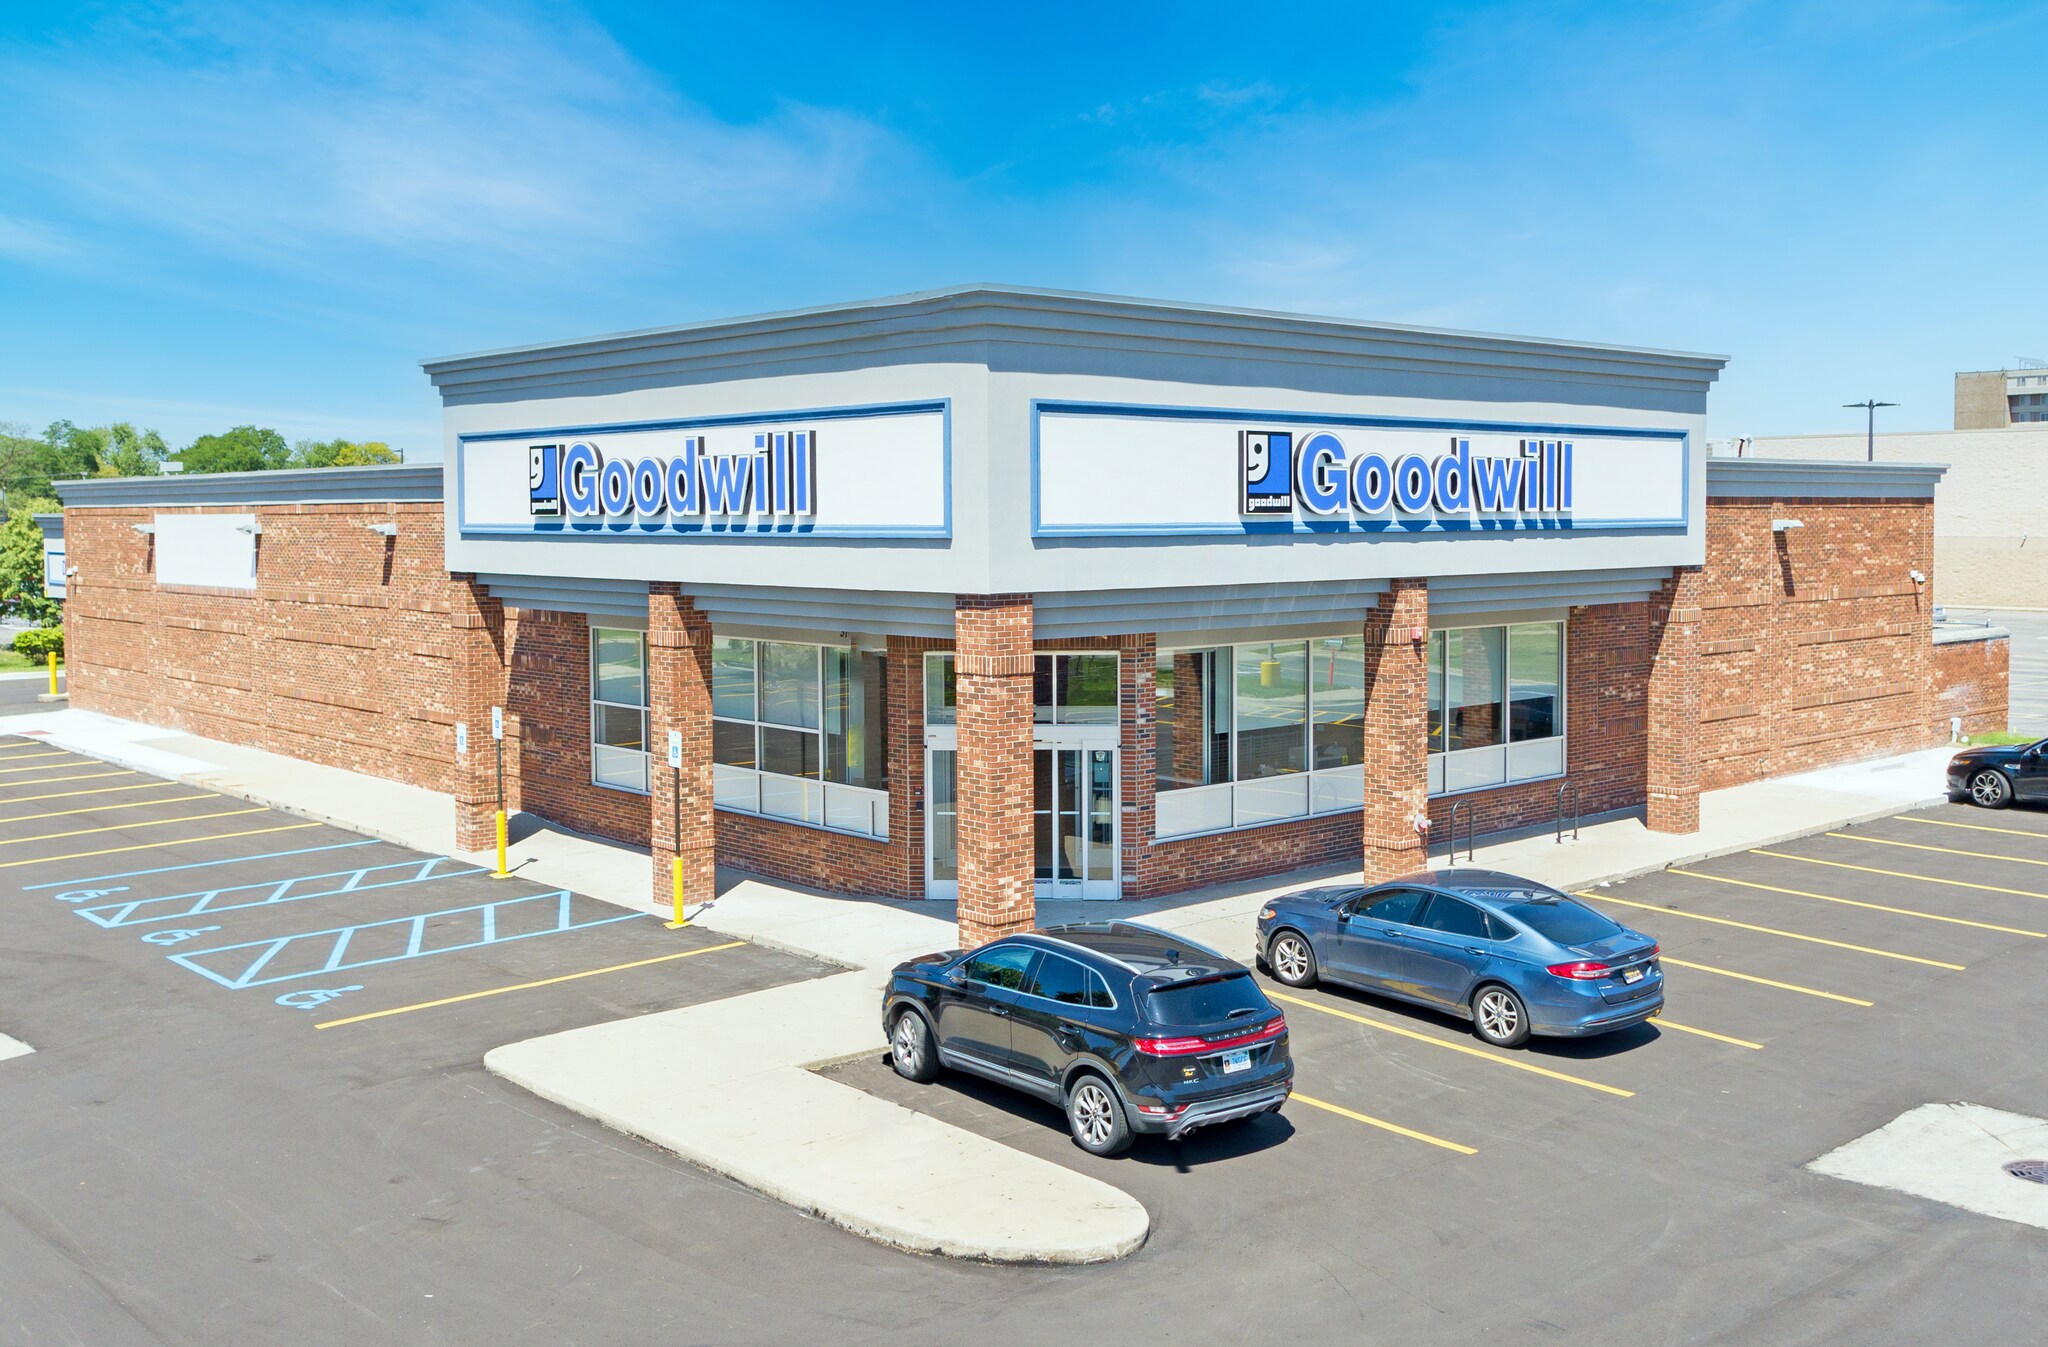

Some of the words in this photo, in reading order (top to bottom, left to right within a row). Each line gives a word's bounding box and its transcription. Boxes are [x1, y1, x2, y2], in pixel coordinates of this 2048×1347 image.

[563, 430, 814, 516] Goodwill
[1296, 431, 1573, 514] Goodwill
[1248, 495, 1290, 511] goodwill
[1208, 1026, 1262, 1041] LINCOLN
